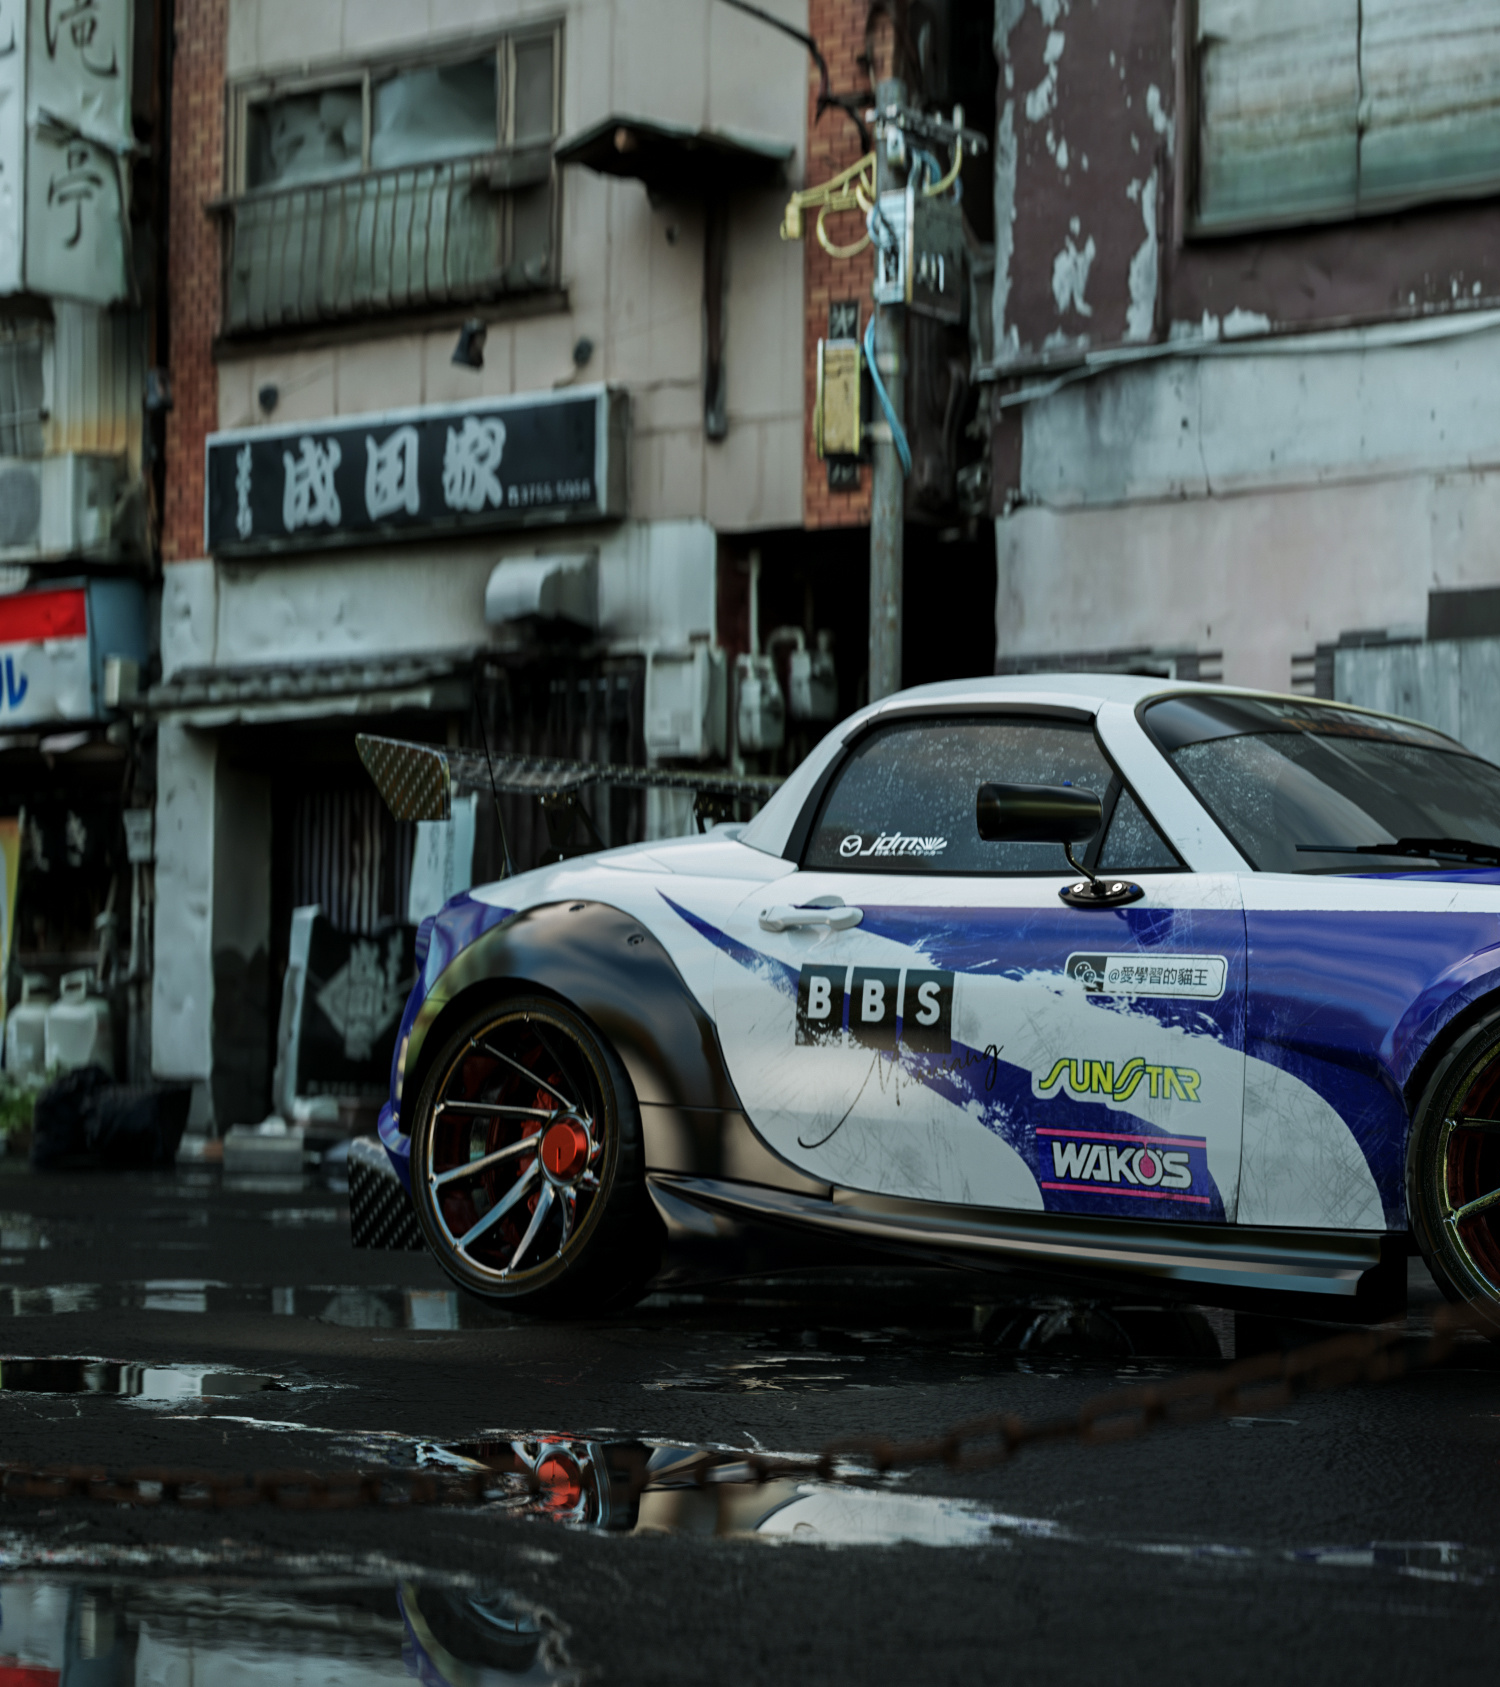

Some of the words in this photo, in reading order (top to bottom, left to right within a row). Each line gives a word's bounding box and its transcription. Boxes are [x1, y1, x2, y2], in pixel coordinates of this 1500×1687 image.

[1108, 965, 1209, 987] @愛學習的貓王
[807, 975, 942, 1026] BBS
[1038, 1056, 1202, 1103] SUNSTAR
